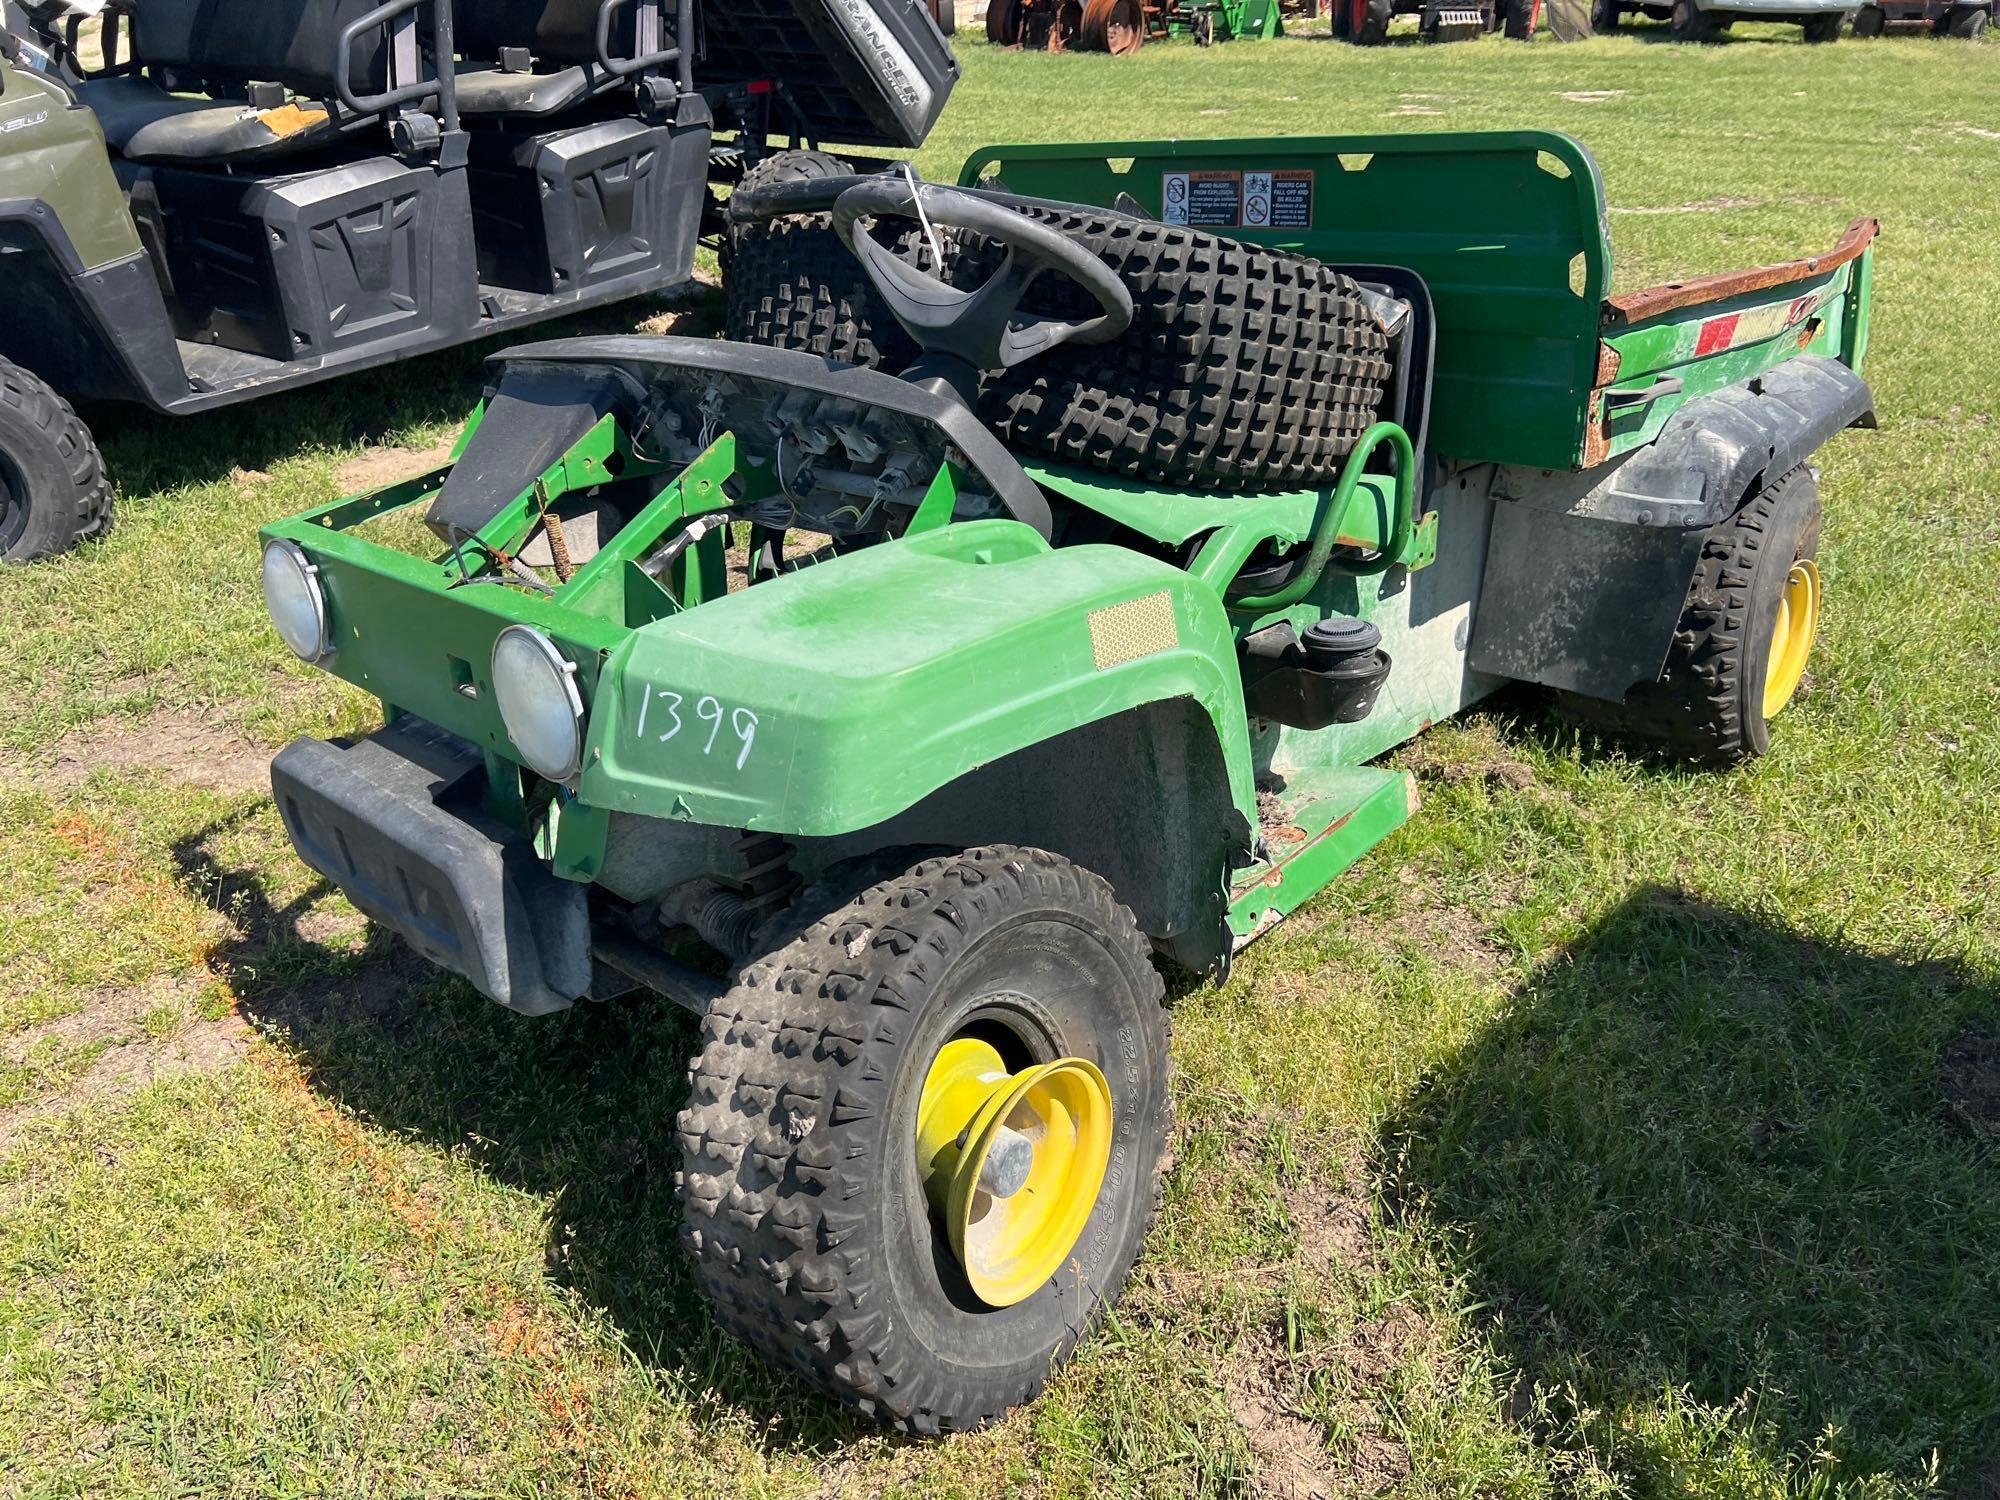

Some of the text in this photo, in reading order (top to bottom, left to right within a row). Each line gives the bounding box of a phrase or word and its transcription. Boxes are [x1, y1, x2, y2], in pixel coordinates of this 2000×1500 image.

[840, 0, 920, 105] RANGER
[881, 68, 910, 106] CREW
[637, 683, 759, 770] 1399
